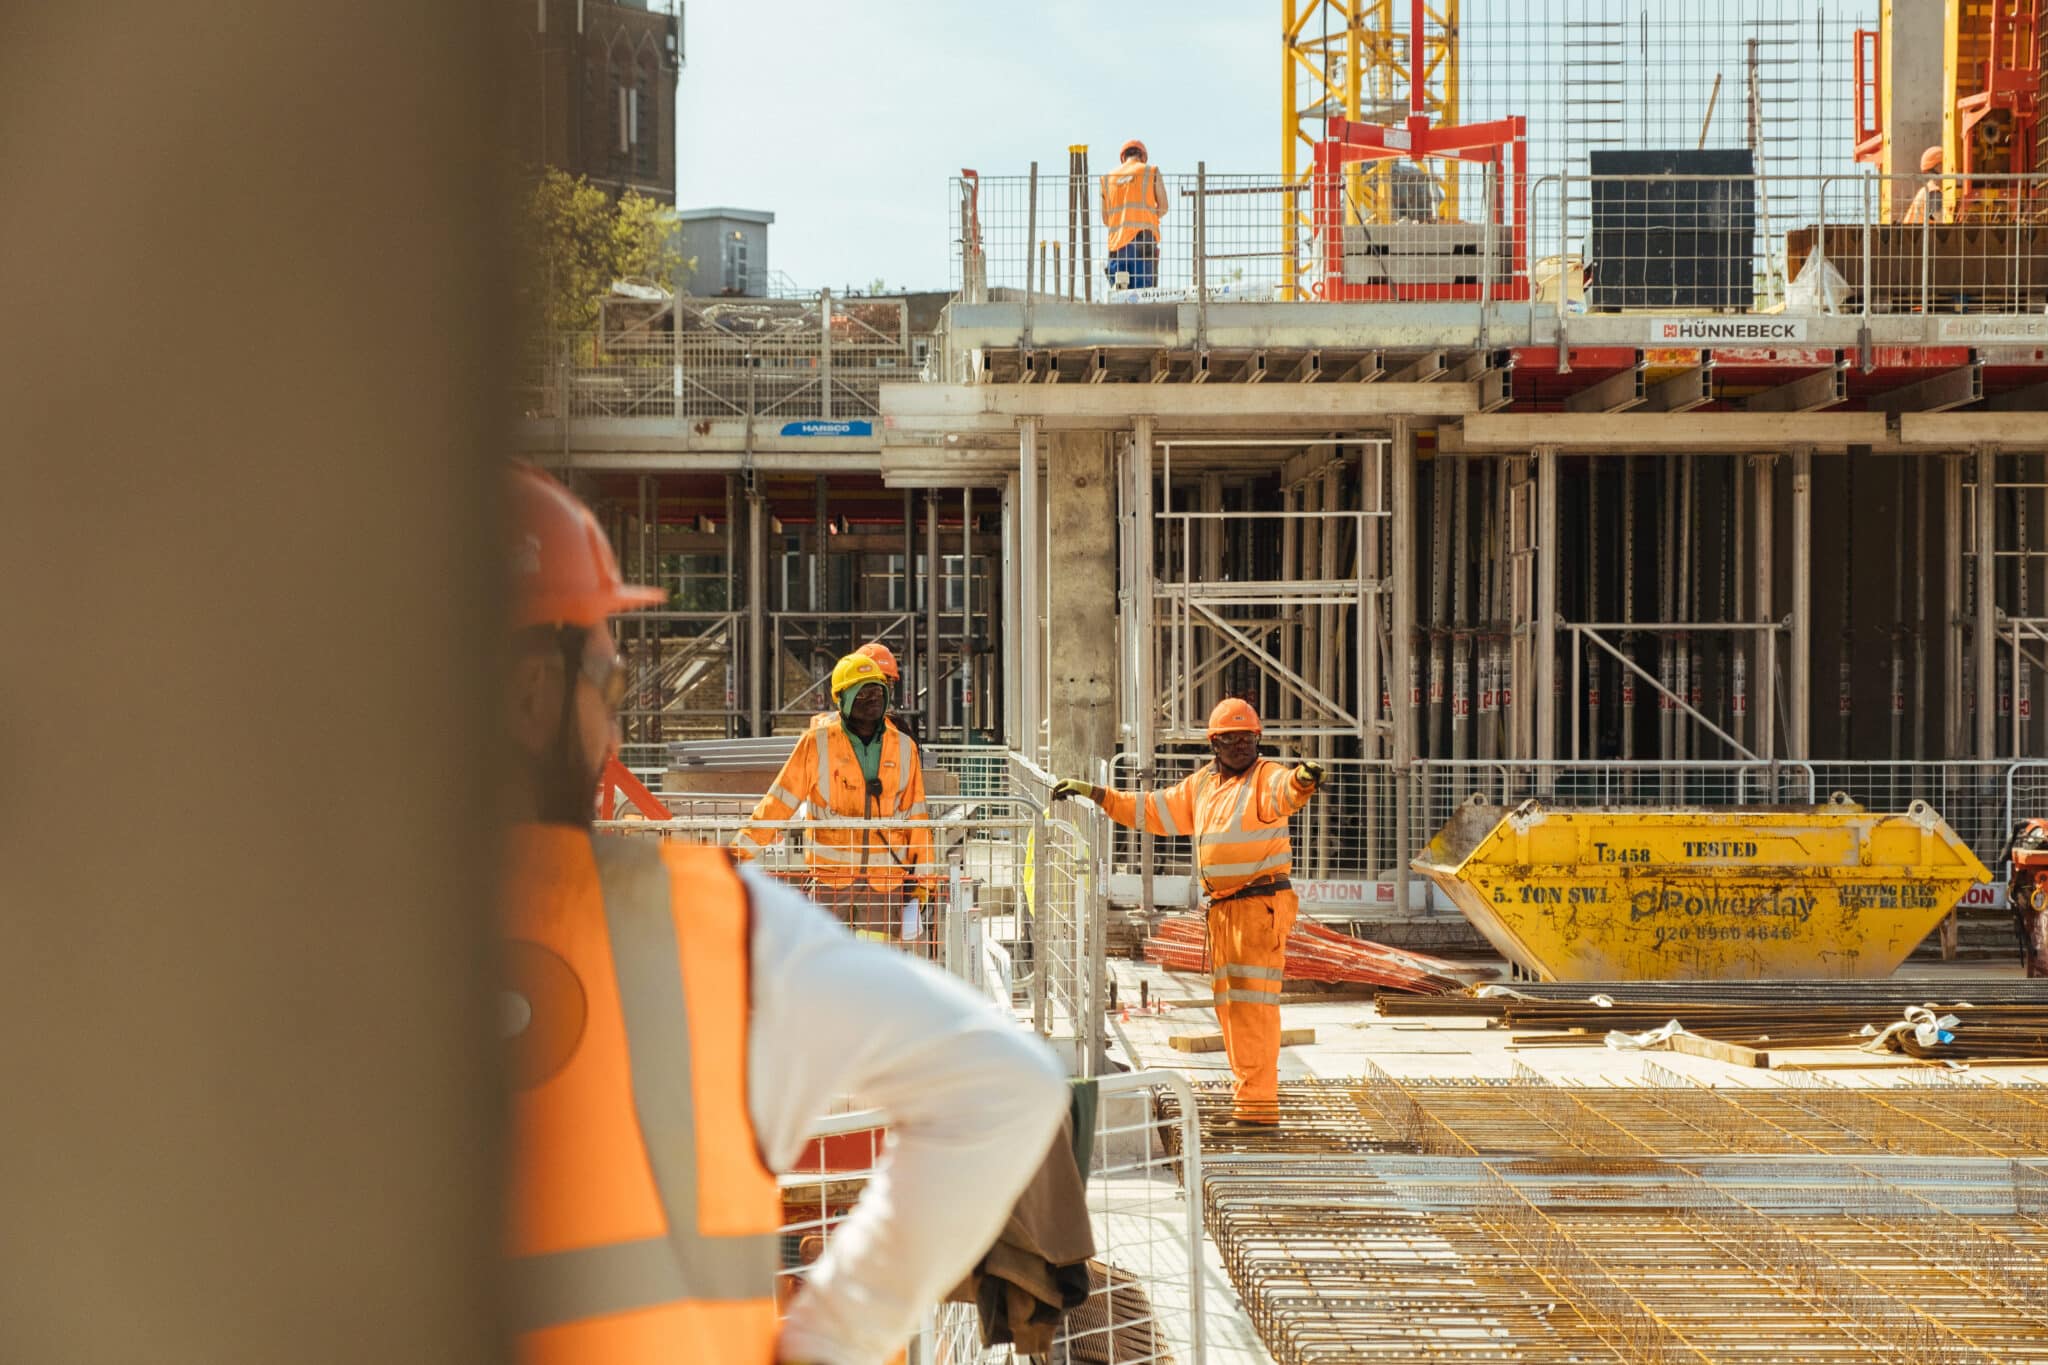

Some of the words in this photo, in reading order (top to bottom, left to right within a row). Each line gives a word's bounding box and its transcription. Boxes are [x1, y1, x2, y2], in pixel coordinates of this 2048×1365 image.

[1680, 321, 1795, 337] HÜNNEBECK
[1594, 843, 1650, 863] T3458
[1683, 841, 1757, 857] TESTED
[1519, 886, 1562, 904] TON
[1843, 884, 1897, 896] LIFTING
[1901, 884, 1935, 896] EYES
[1662, 888, 1817, 922] Powerday
